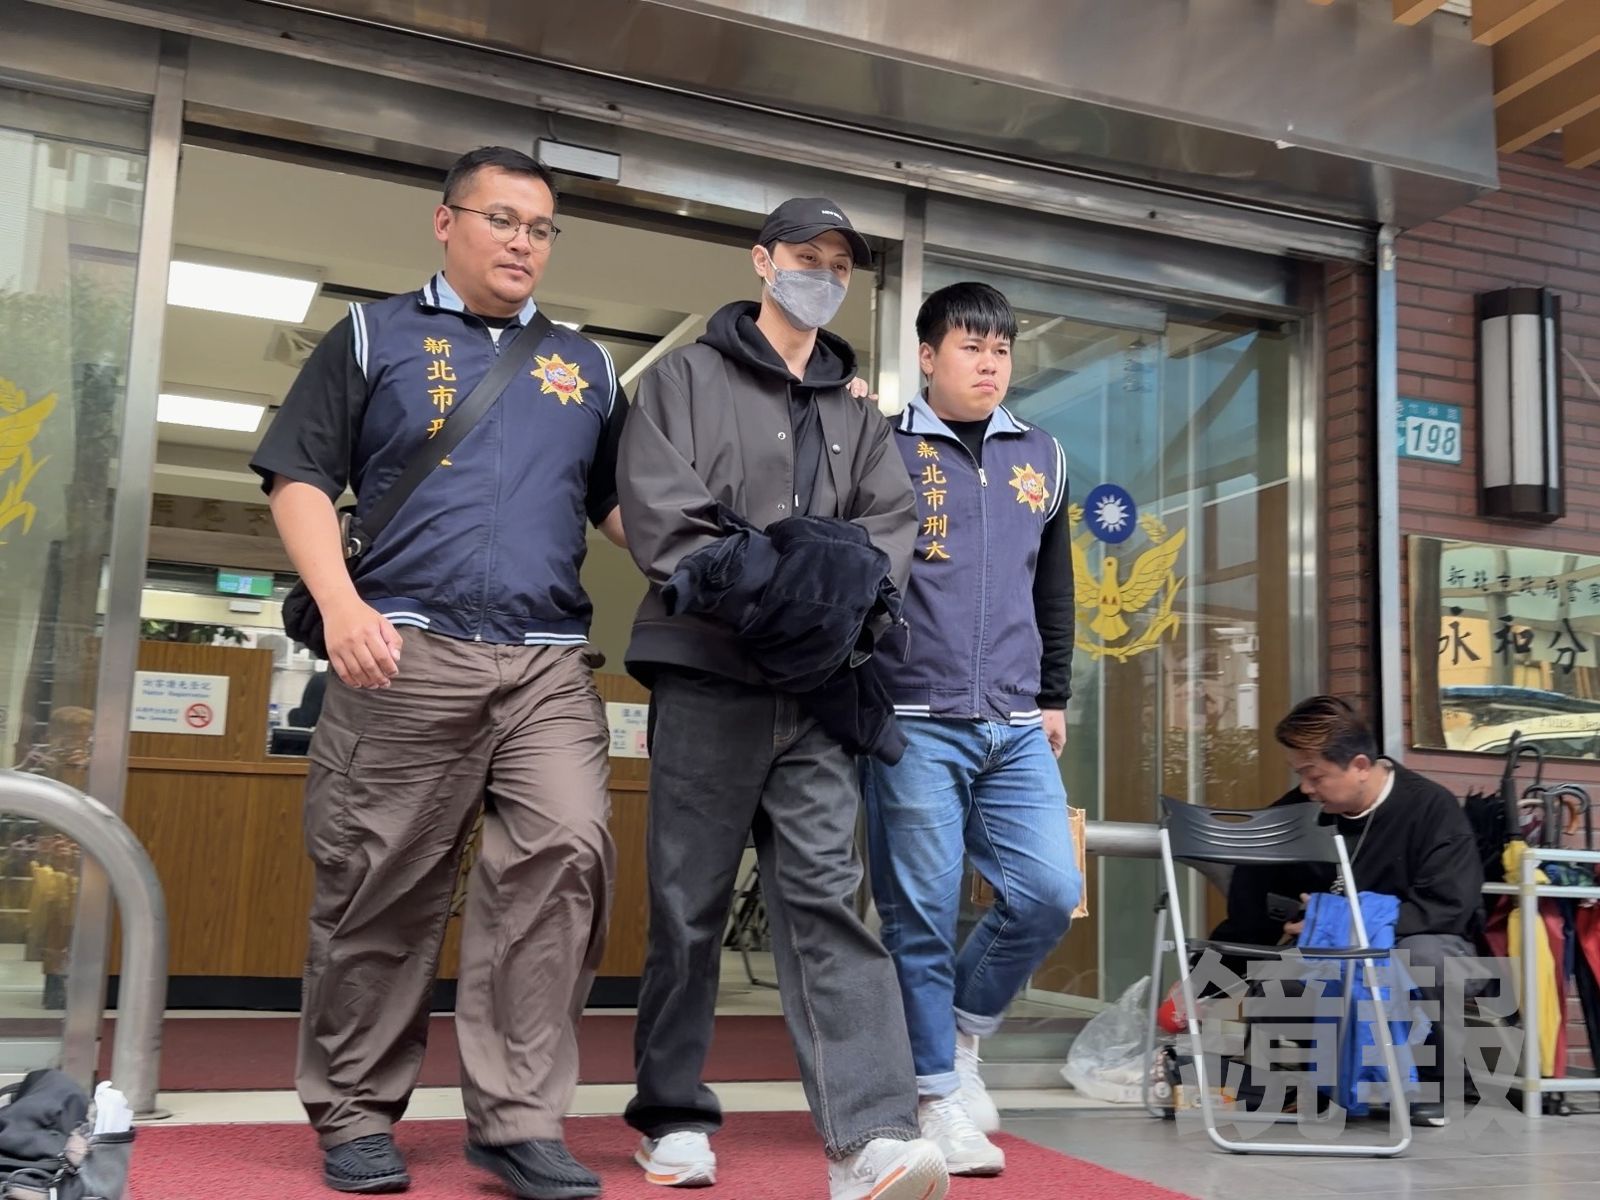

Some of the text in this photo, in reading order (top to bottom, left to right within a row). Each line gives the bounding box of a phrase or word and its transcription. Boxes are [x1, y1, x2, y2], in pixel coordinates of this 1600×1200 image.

[424, 337, 457, 466] 新北市
[1411, 422, 1456, 456] 198
[917, 441, 951, 561] 新北市刑大
[1436, 605, 1588, 675] 永和分
